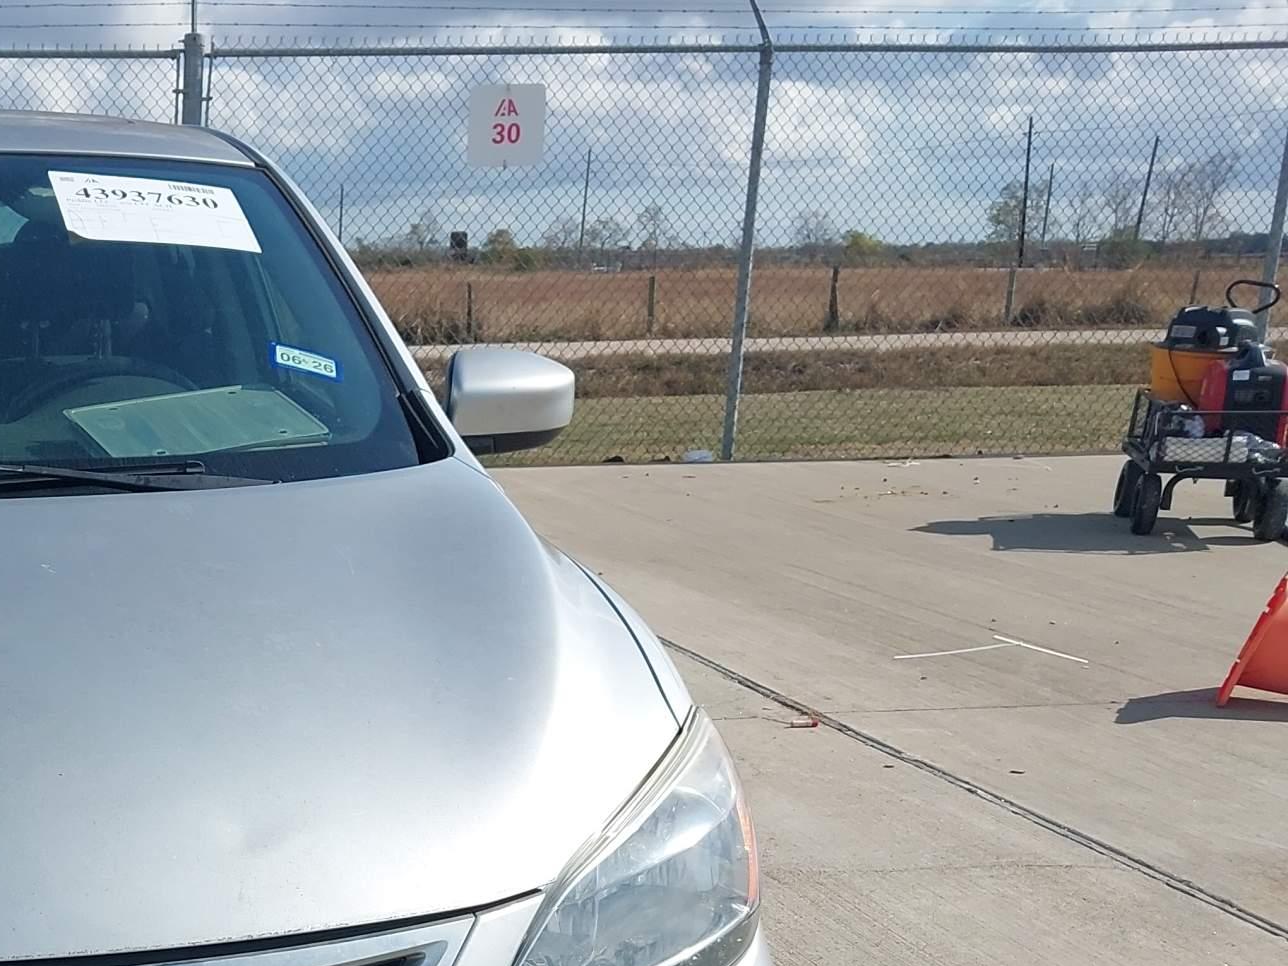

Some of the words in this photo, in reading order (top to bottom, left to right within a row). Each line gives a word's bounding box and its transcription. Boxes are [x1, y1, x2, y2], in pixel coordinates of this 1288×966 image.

[491, 122, 521, 145] 30
[74, 186, 219, 209] 43937630
[279, 351, 303, 366] 06
[311, 360, 335, 374] 26
